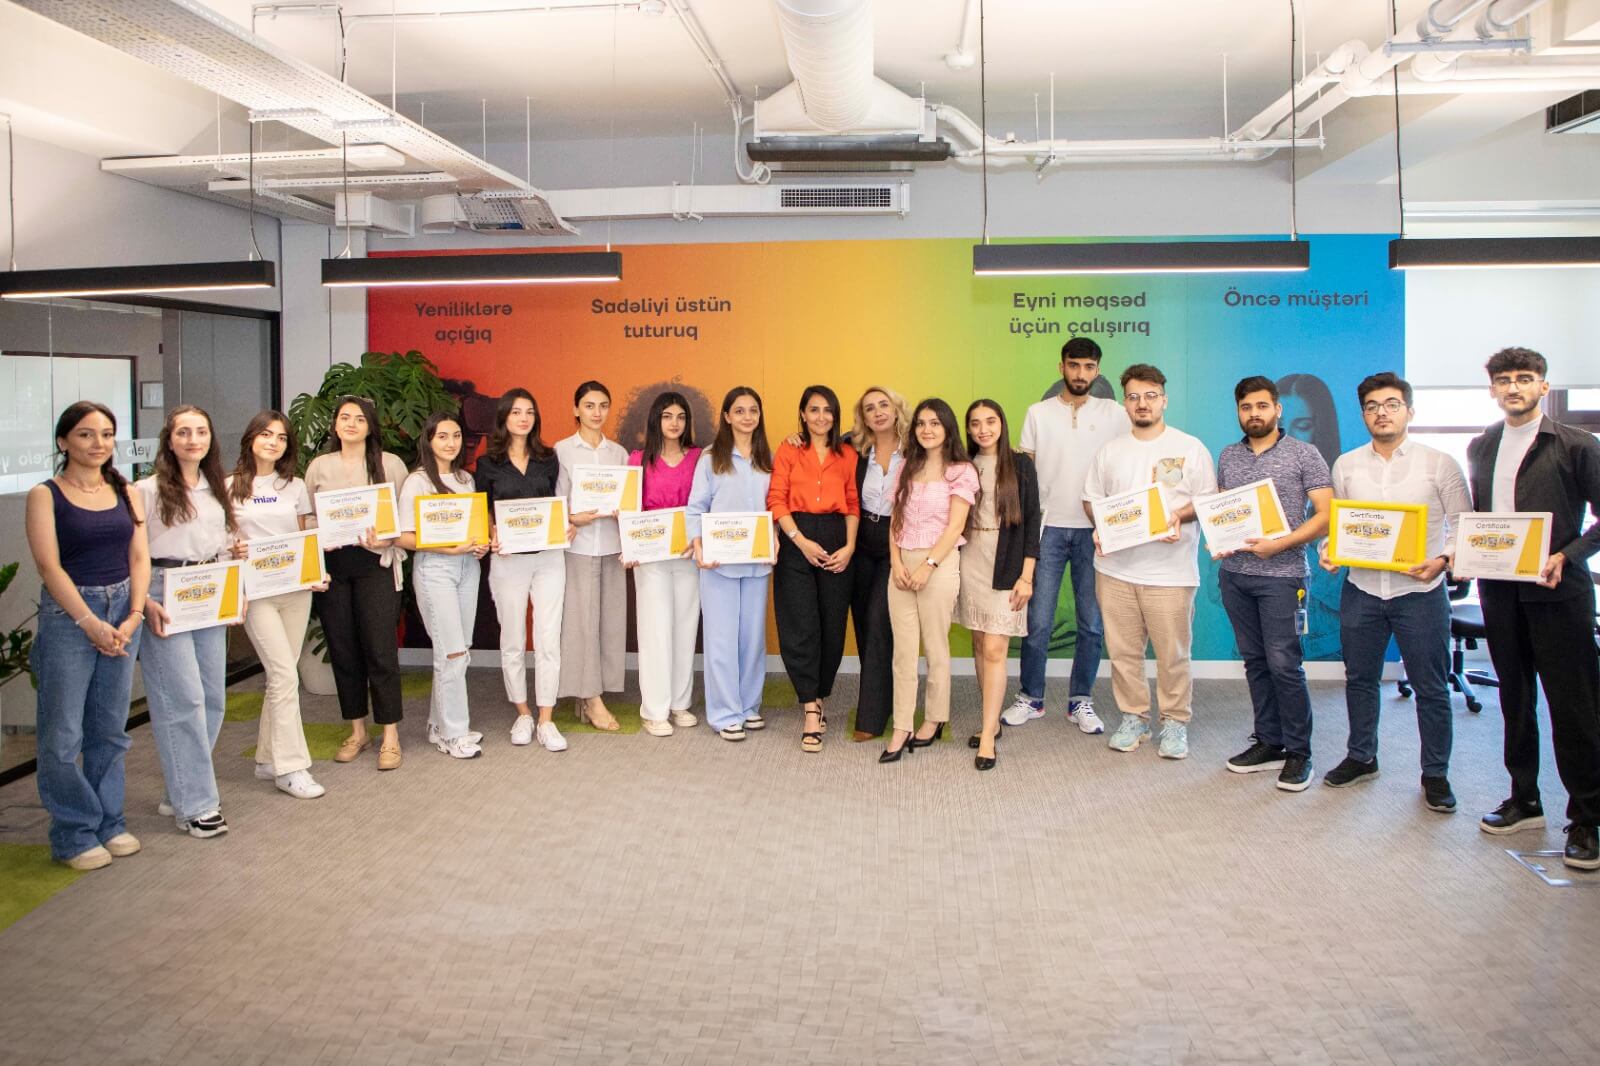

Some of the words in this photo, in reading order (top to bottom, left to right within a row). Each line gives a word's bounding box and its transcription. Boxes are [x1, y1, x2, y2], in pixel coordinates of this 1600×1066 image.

[591, 298, 669, 317] Sadəliyi
[675, 296, 732, 312] üstün
[1013, 292, 1056, 311] Eyni
[1063, 291, 1146, 311] məqsəd
[1223, 287, 1281, 306] Öncə
[1288, 290, 1369, 311] müştəri
[415, 301, 513, 317] Yeniliklərə
[435, 325, 492, 344] açığıq
[624, 324, 698, 341] tuturuq
[1009, 317, 1060, 338] üçün
[1067, 317, 1151, 338] çalışırıq
[253, 496, 278, 504] miav
